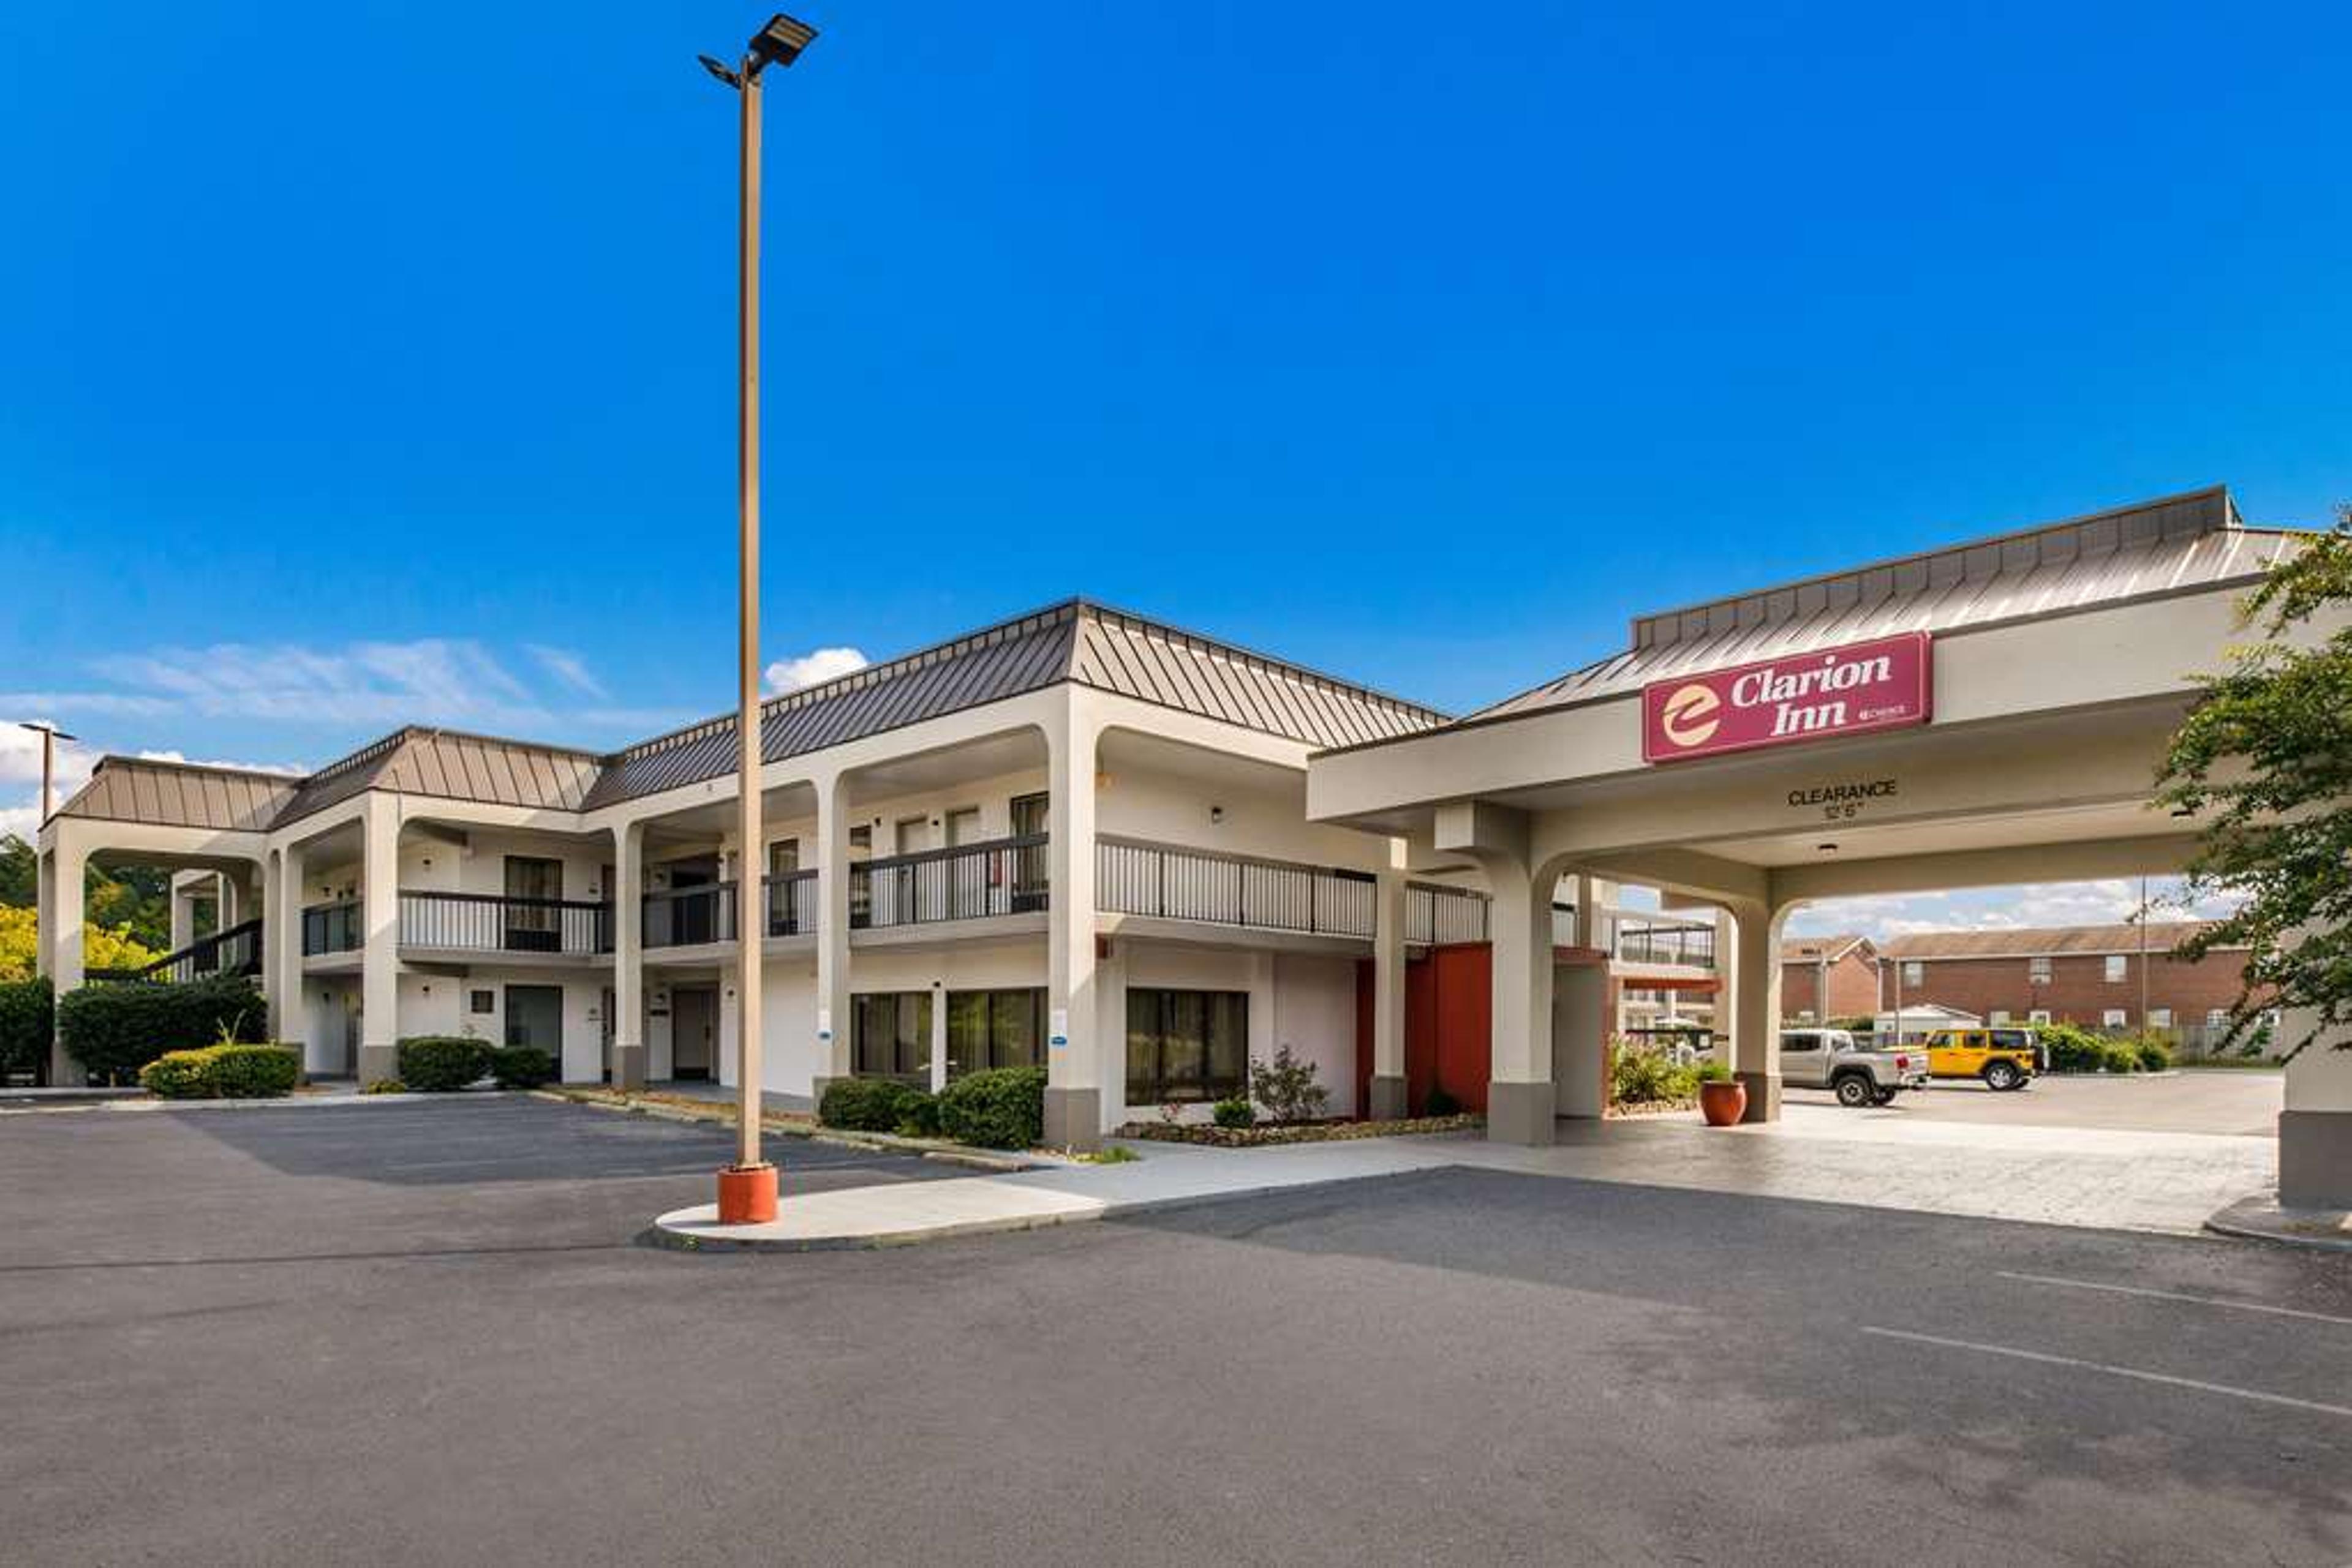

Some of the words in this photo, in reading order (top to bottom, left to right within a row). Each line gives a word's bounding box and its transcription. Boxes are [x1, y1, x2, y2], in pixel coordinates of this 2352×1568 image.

[1732, 655, 1891, 706] Clarion
[1770, 701, 1847, 736] Inn
[1788, 780, 1896, 807] CLEARANCE
